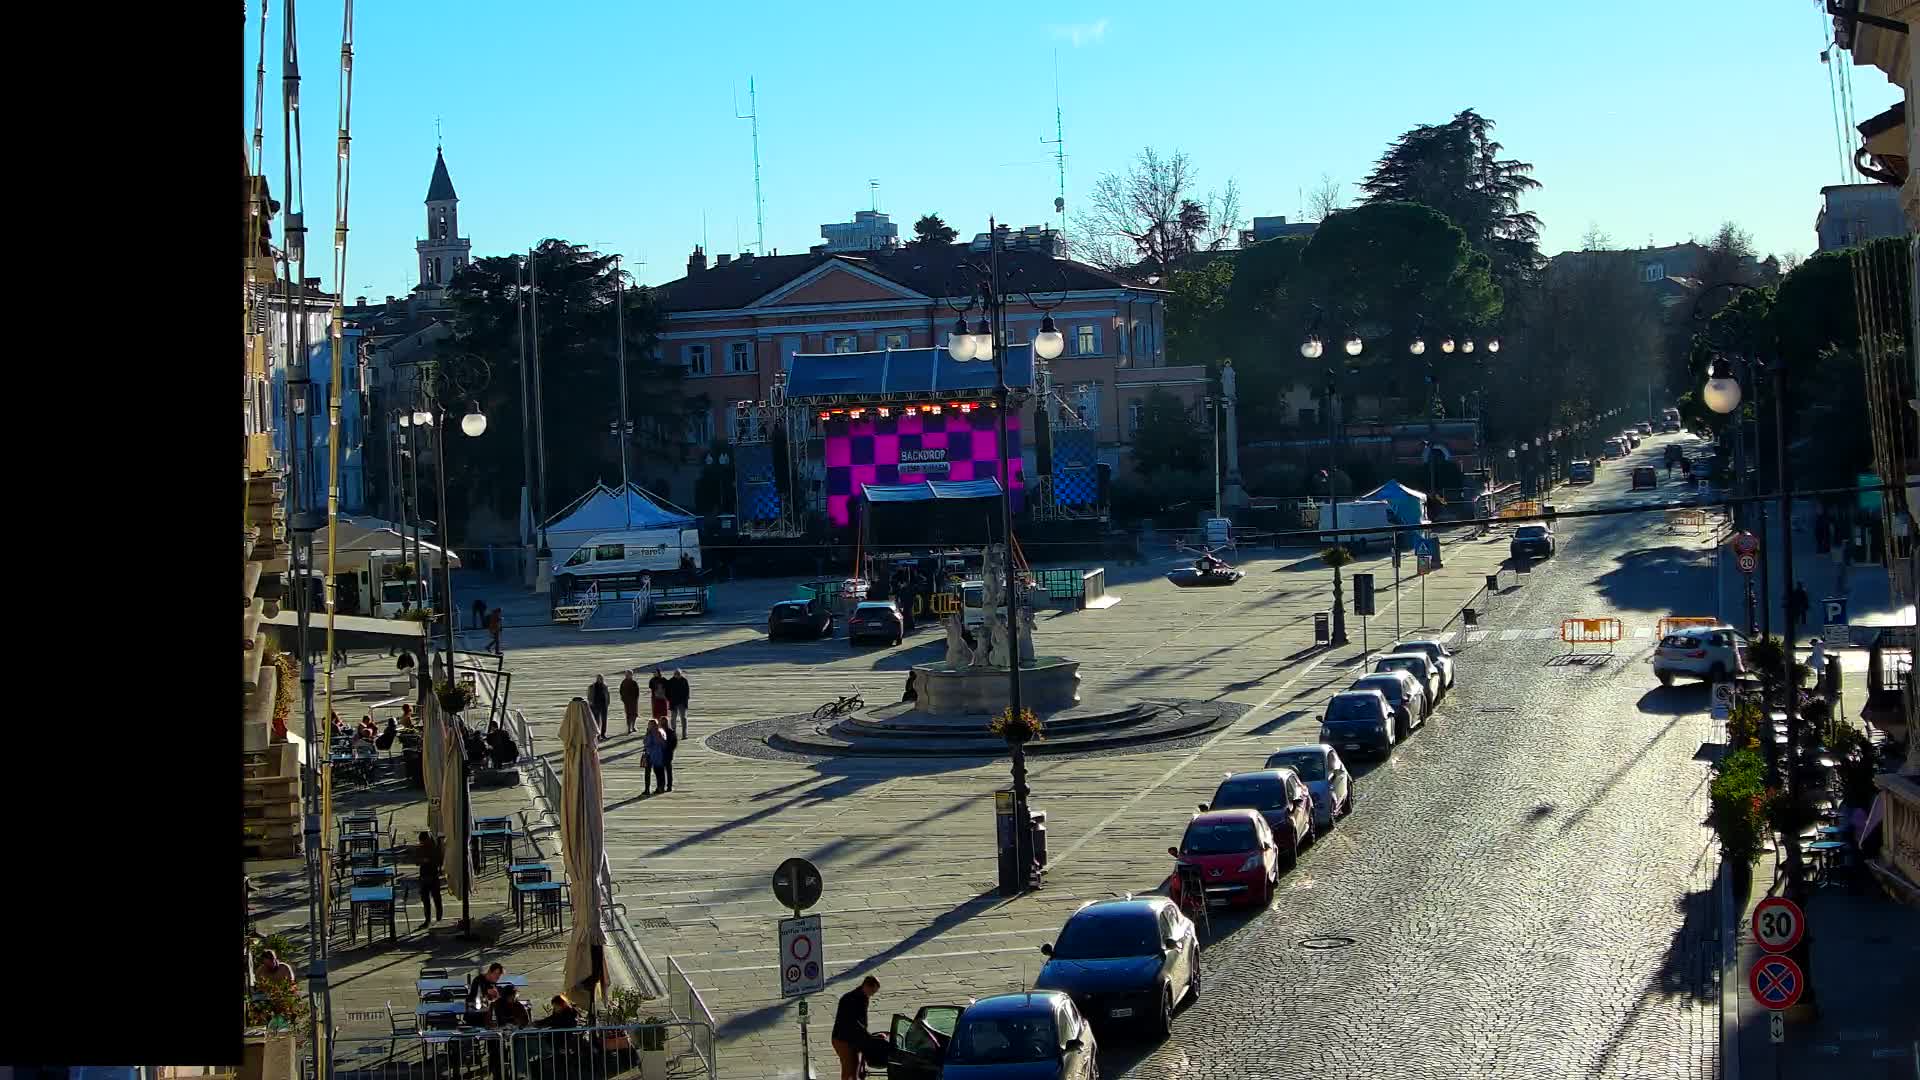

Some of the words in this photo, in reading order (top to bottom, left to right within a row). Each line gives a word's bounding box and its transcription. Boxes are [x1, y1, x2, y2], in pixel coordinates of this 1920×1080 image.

[901, 449, 946, 461] BACKDROP
[1742, 558, 1753, 568] 20
[1827, 602, 1842, 622] P
[1762, 911, 1792, 938] 30
